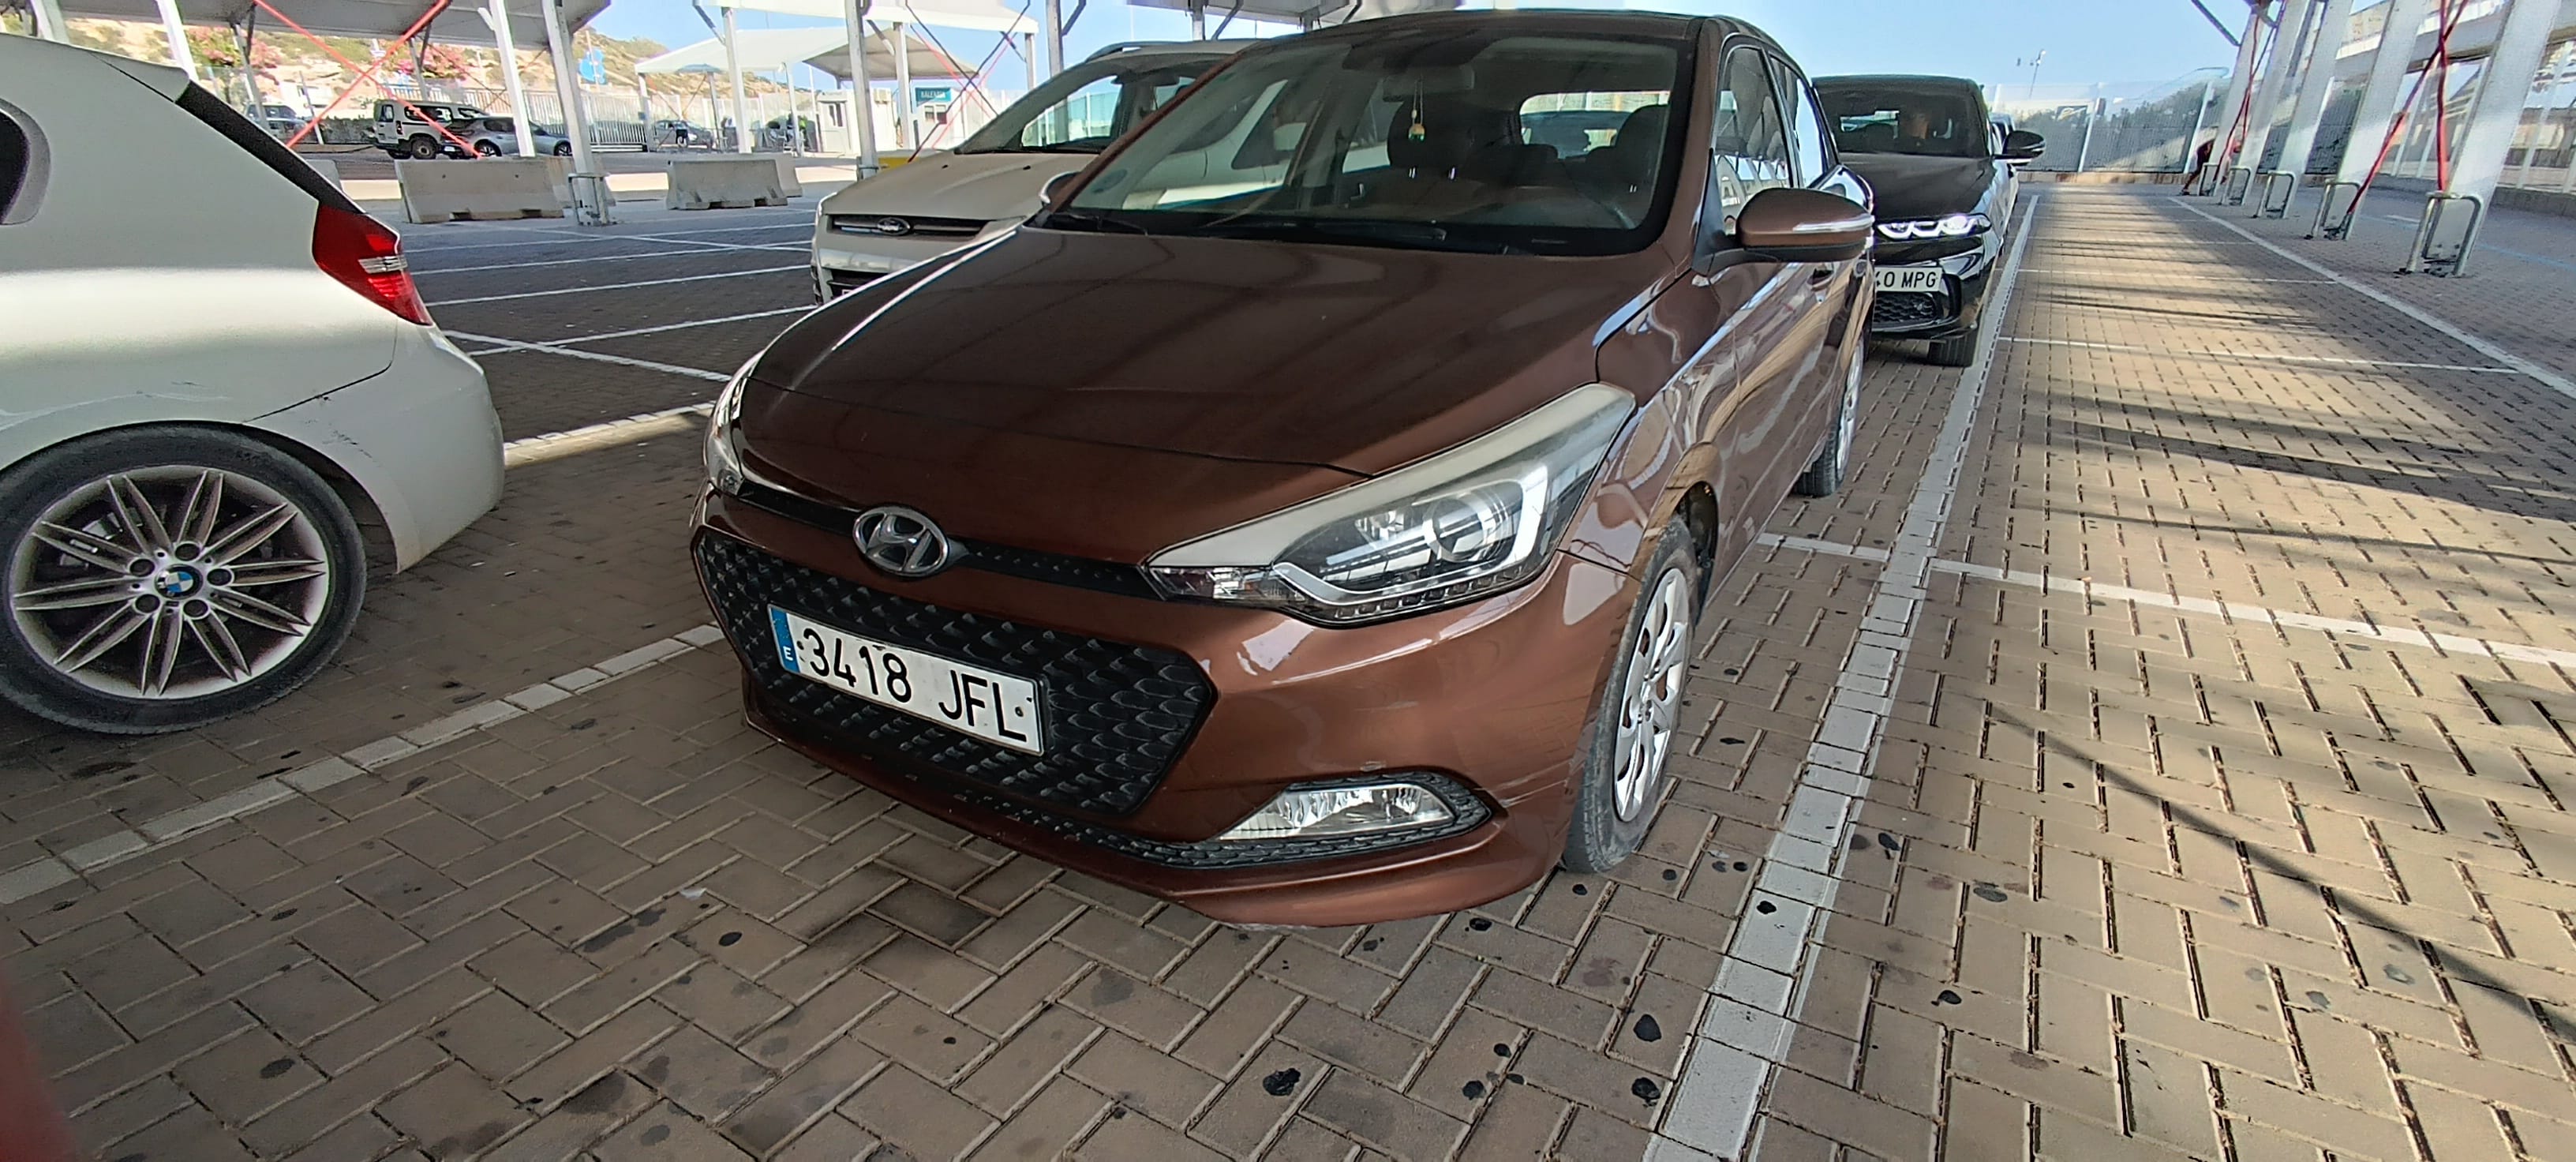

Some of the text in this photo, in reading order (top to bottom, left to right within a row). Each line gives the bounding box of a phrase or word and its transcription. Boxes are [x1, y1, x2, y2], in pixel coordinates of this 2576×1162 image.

[1901, 271, 1937, 288] MPG
[782, 646, 794, 661] E
[803, 628, 1027, 742] 3418 JFL
